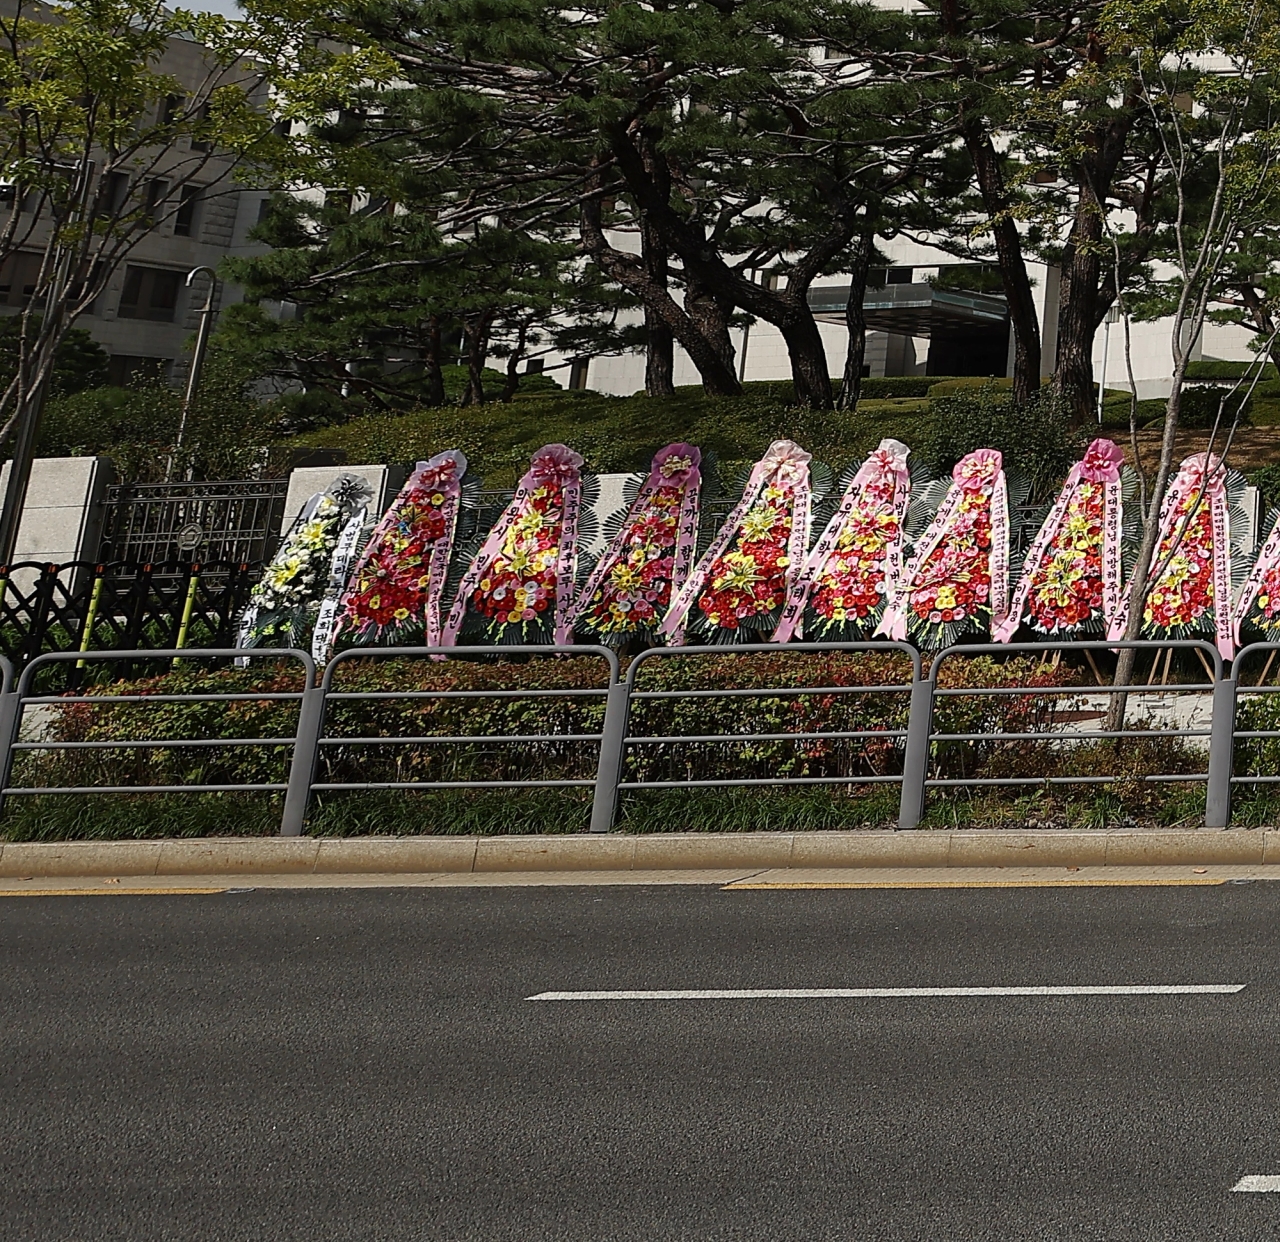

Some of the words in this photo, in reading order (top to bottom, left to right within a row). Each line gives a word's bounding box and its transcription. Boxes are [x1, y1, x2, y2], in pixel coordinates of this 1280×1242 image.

[493, 485, 530, 540] 의왕시
[564, 487, 582, 536] 민주주의
[818, 480, 861, 557] 자유대학
[931, 489, 962, 528] 윤어게인
[1107, 485, 1119, 542] 윤대통령님
[908, 526, 938, 576] 대전시민
[442, 552, 490, 630] 민주시민
[781, 567, 815, 622] 조태희
